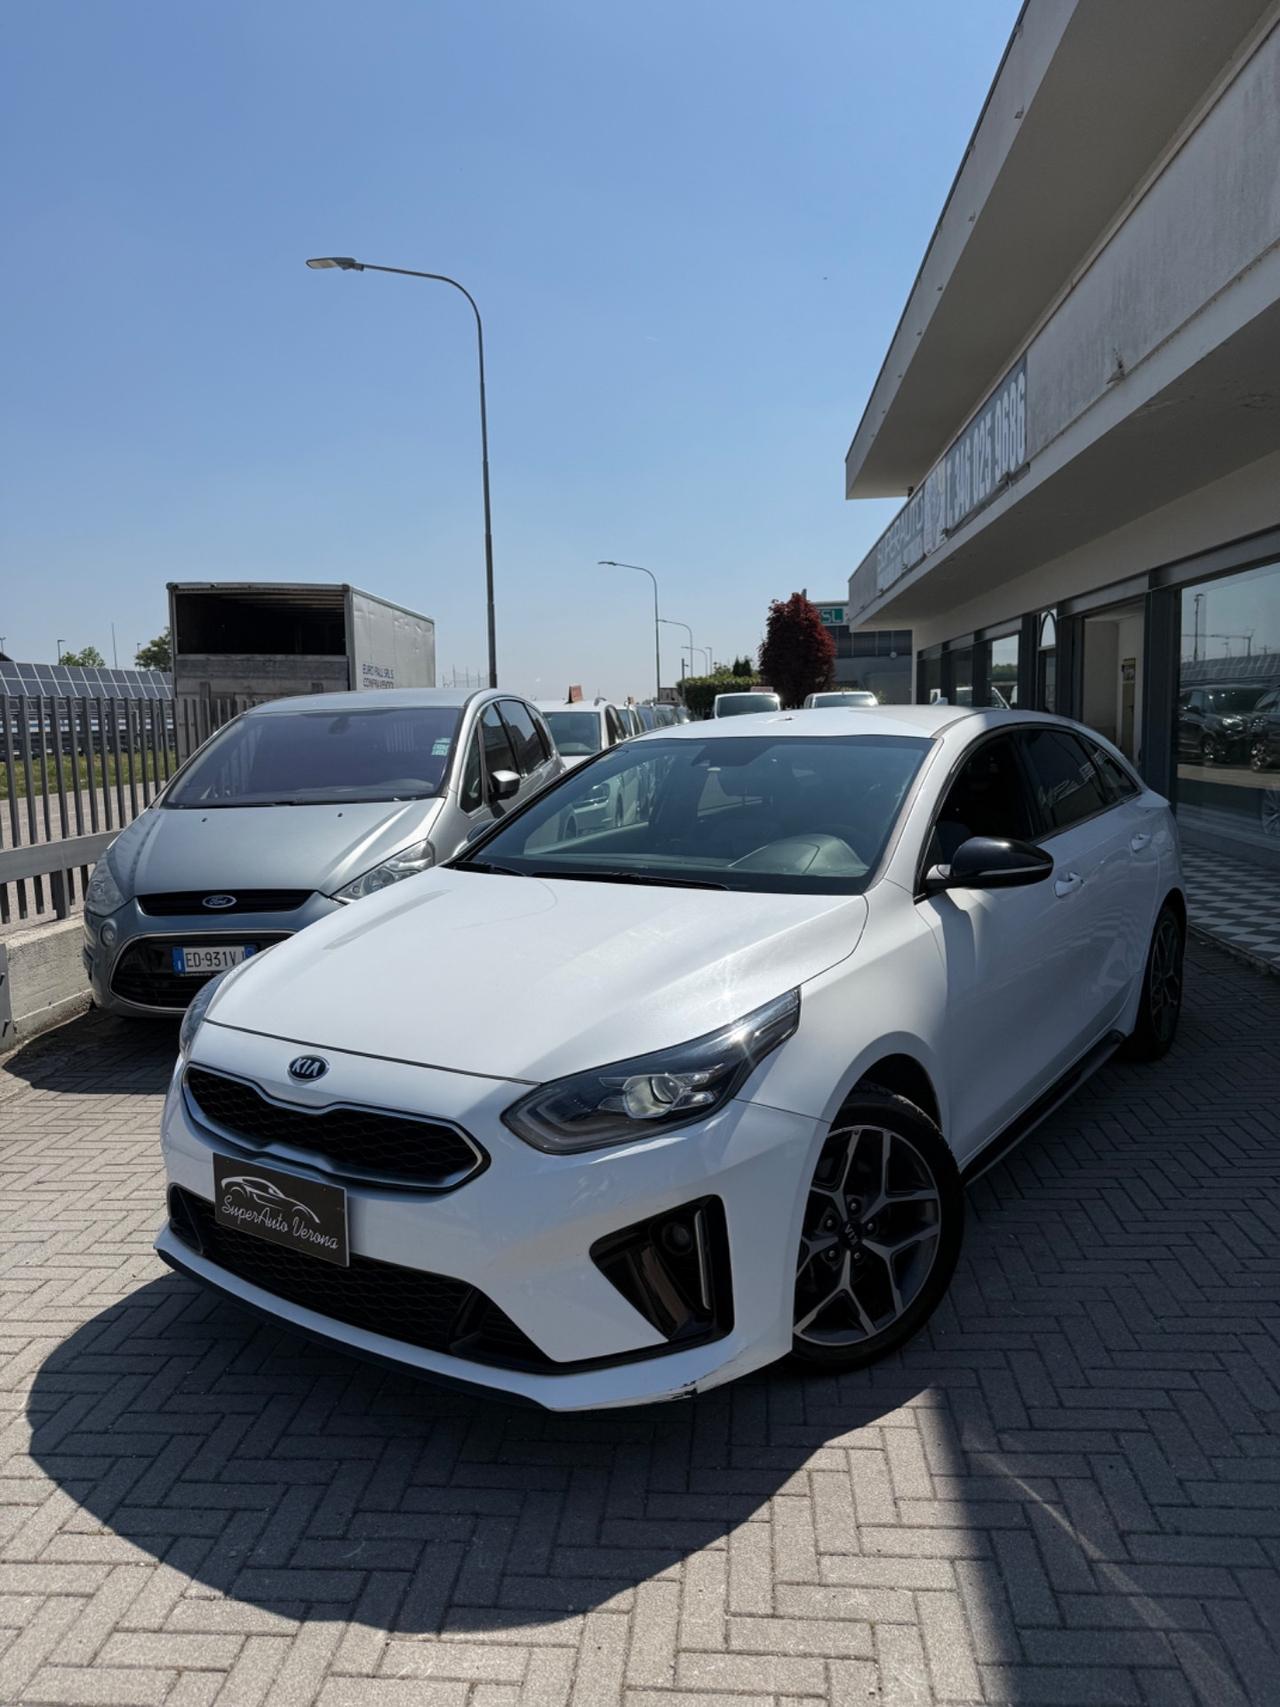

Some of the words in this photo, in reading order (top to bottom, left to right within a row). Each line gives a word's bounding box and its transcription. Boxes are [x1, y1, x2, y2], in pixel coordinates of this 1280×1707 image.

[973, 411, 992, 504] 025
[994, 371, 1025, 483] 9686
[292, 1058, 320, 1077] KIA
[221, 1196, 288, 1233] SuperAuto
[293, 1216, 340, 1250] Verona
